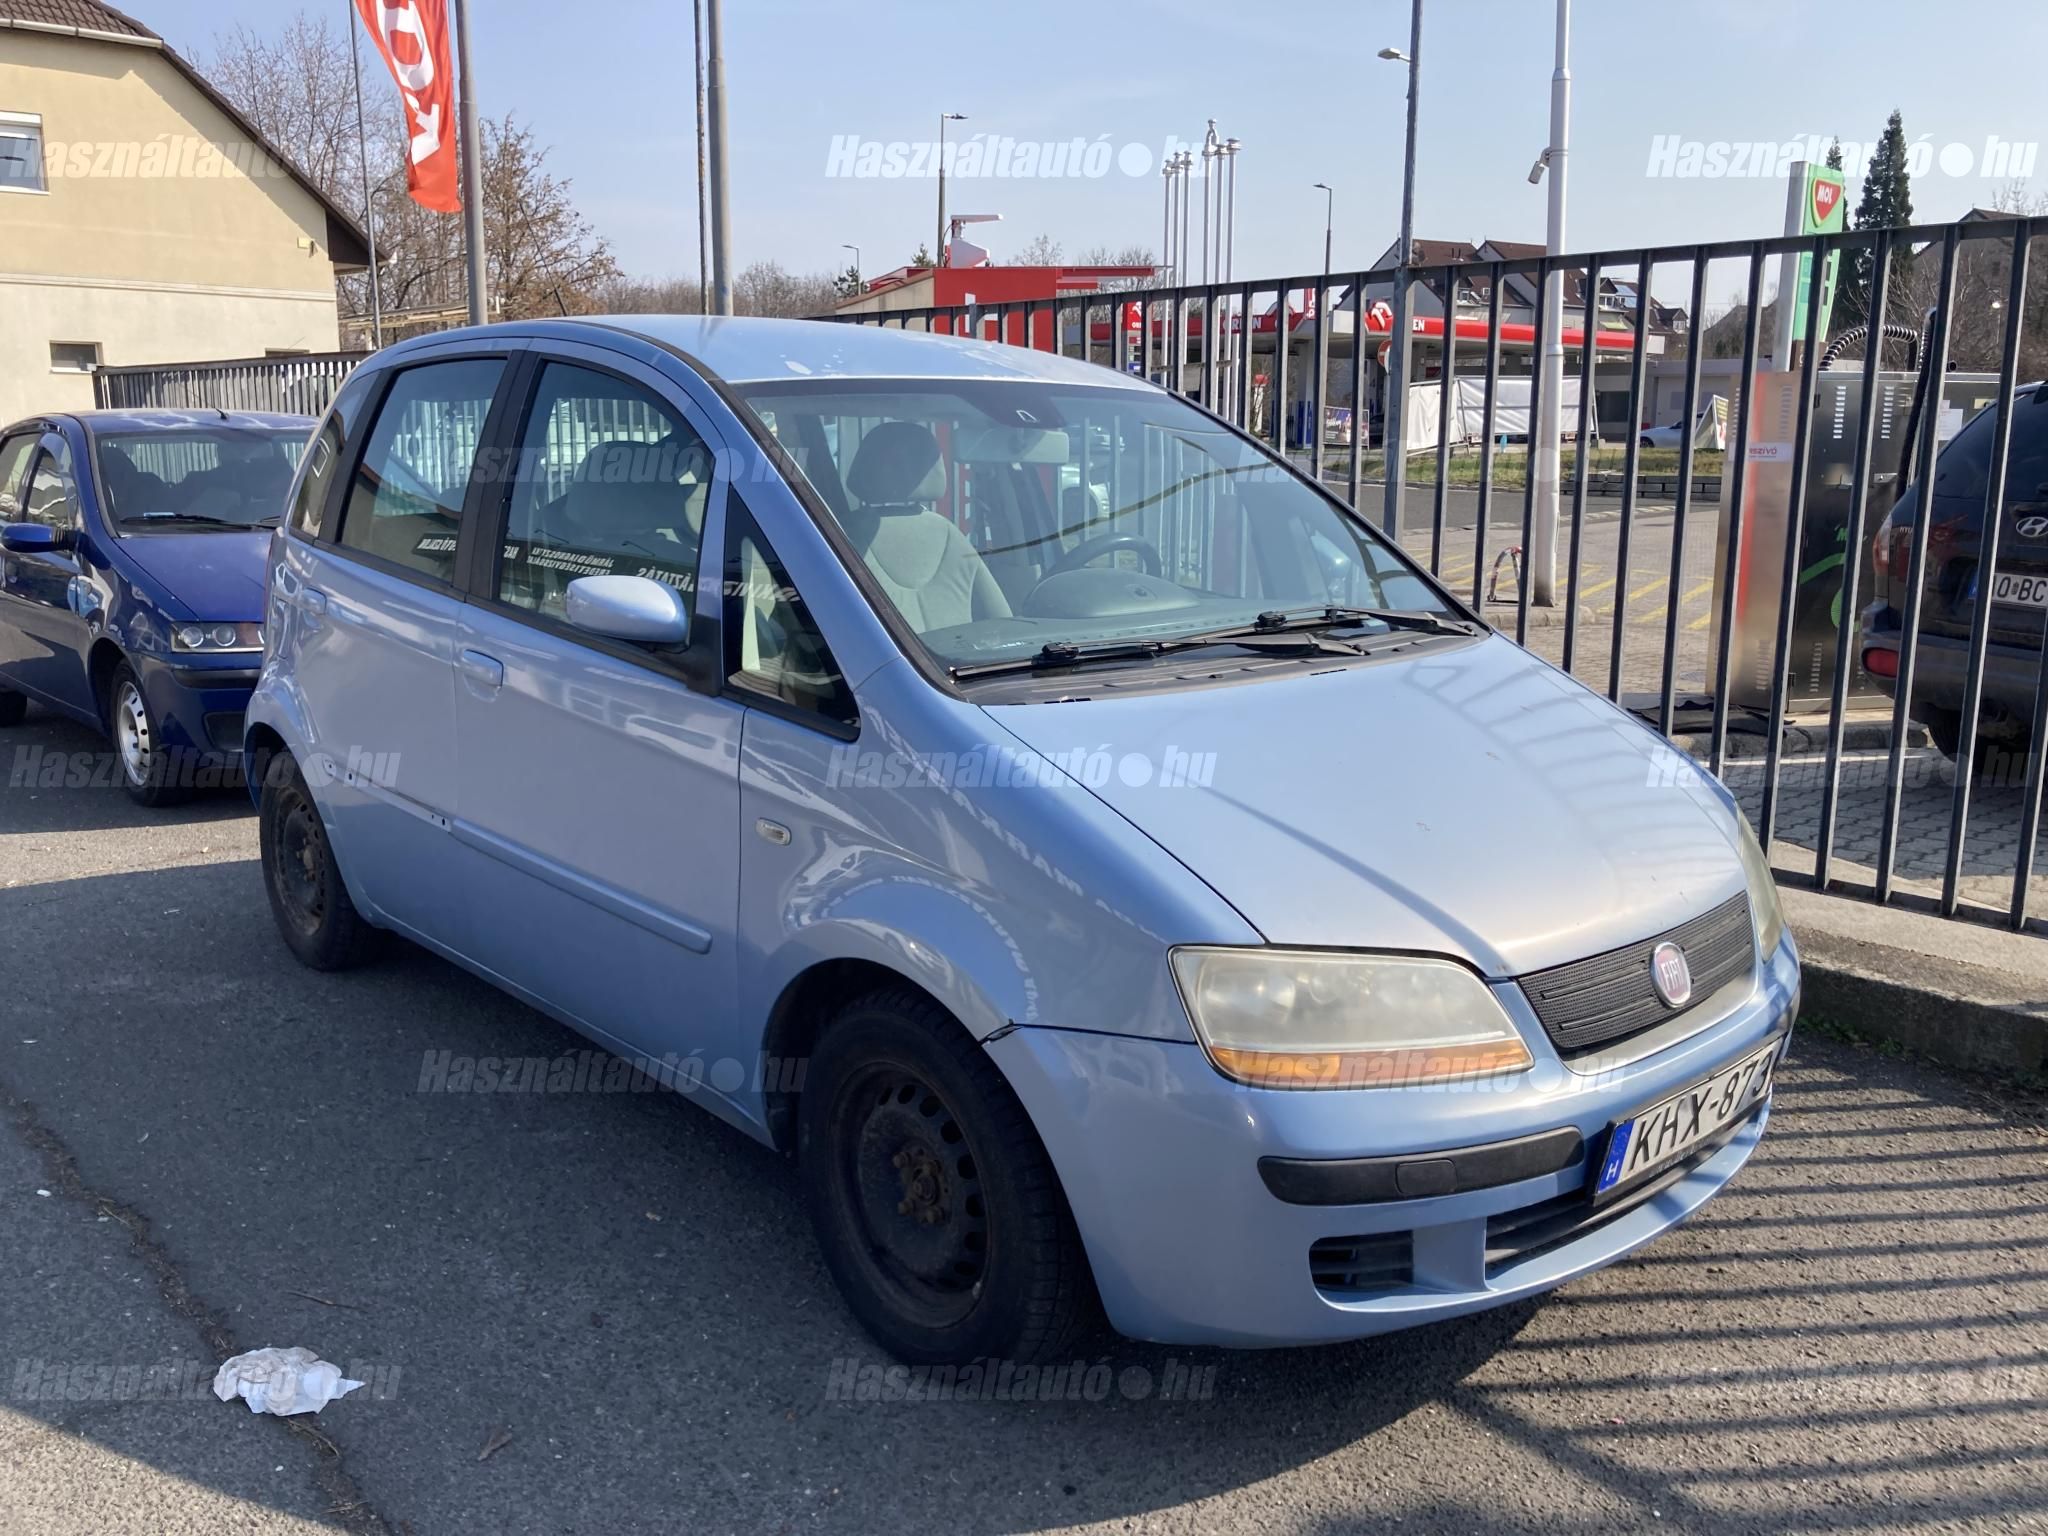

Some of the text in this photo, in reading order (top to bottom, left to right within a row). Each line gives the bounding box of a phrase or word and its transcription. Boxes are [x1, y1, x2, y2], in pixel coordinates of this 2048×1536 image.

[1816, 184, 1833, 204] MOL
[1660, 957, 1686, 993] FIAT
[1628, 1050, 1774, 1173] KHX-873
[1606, 1159, 1620, 1182] H
